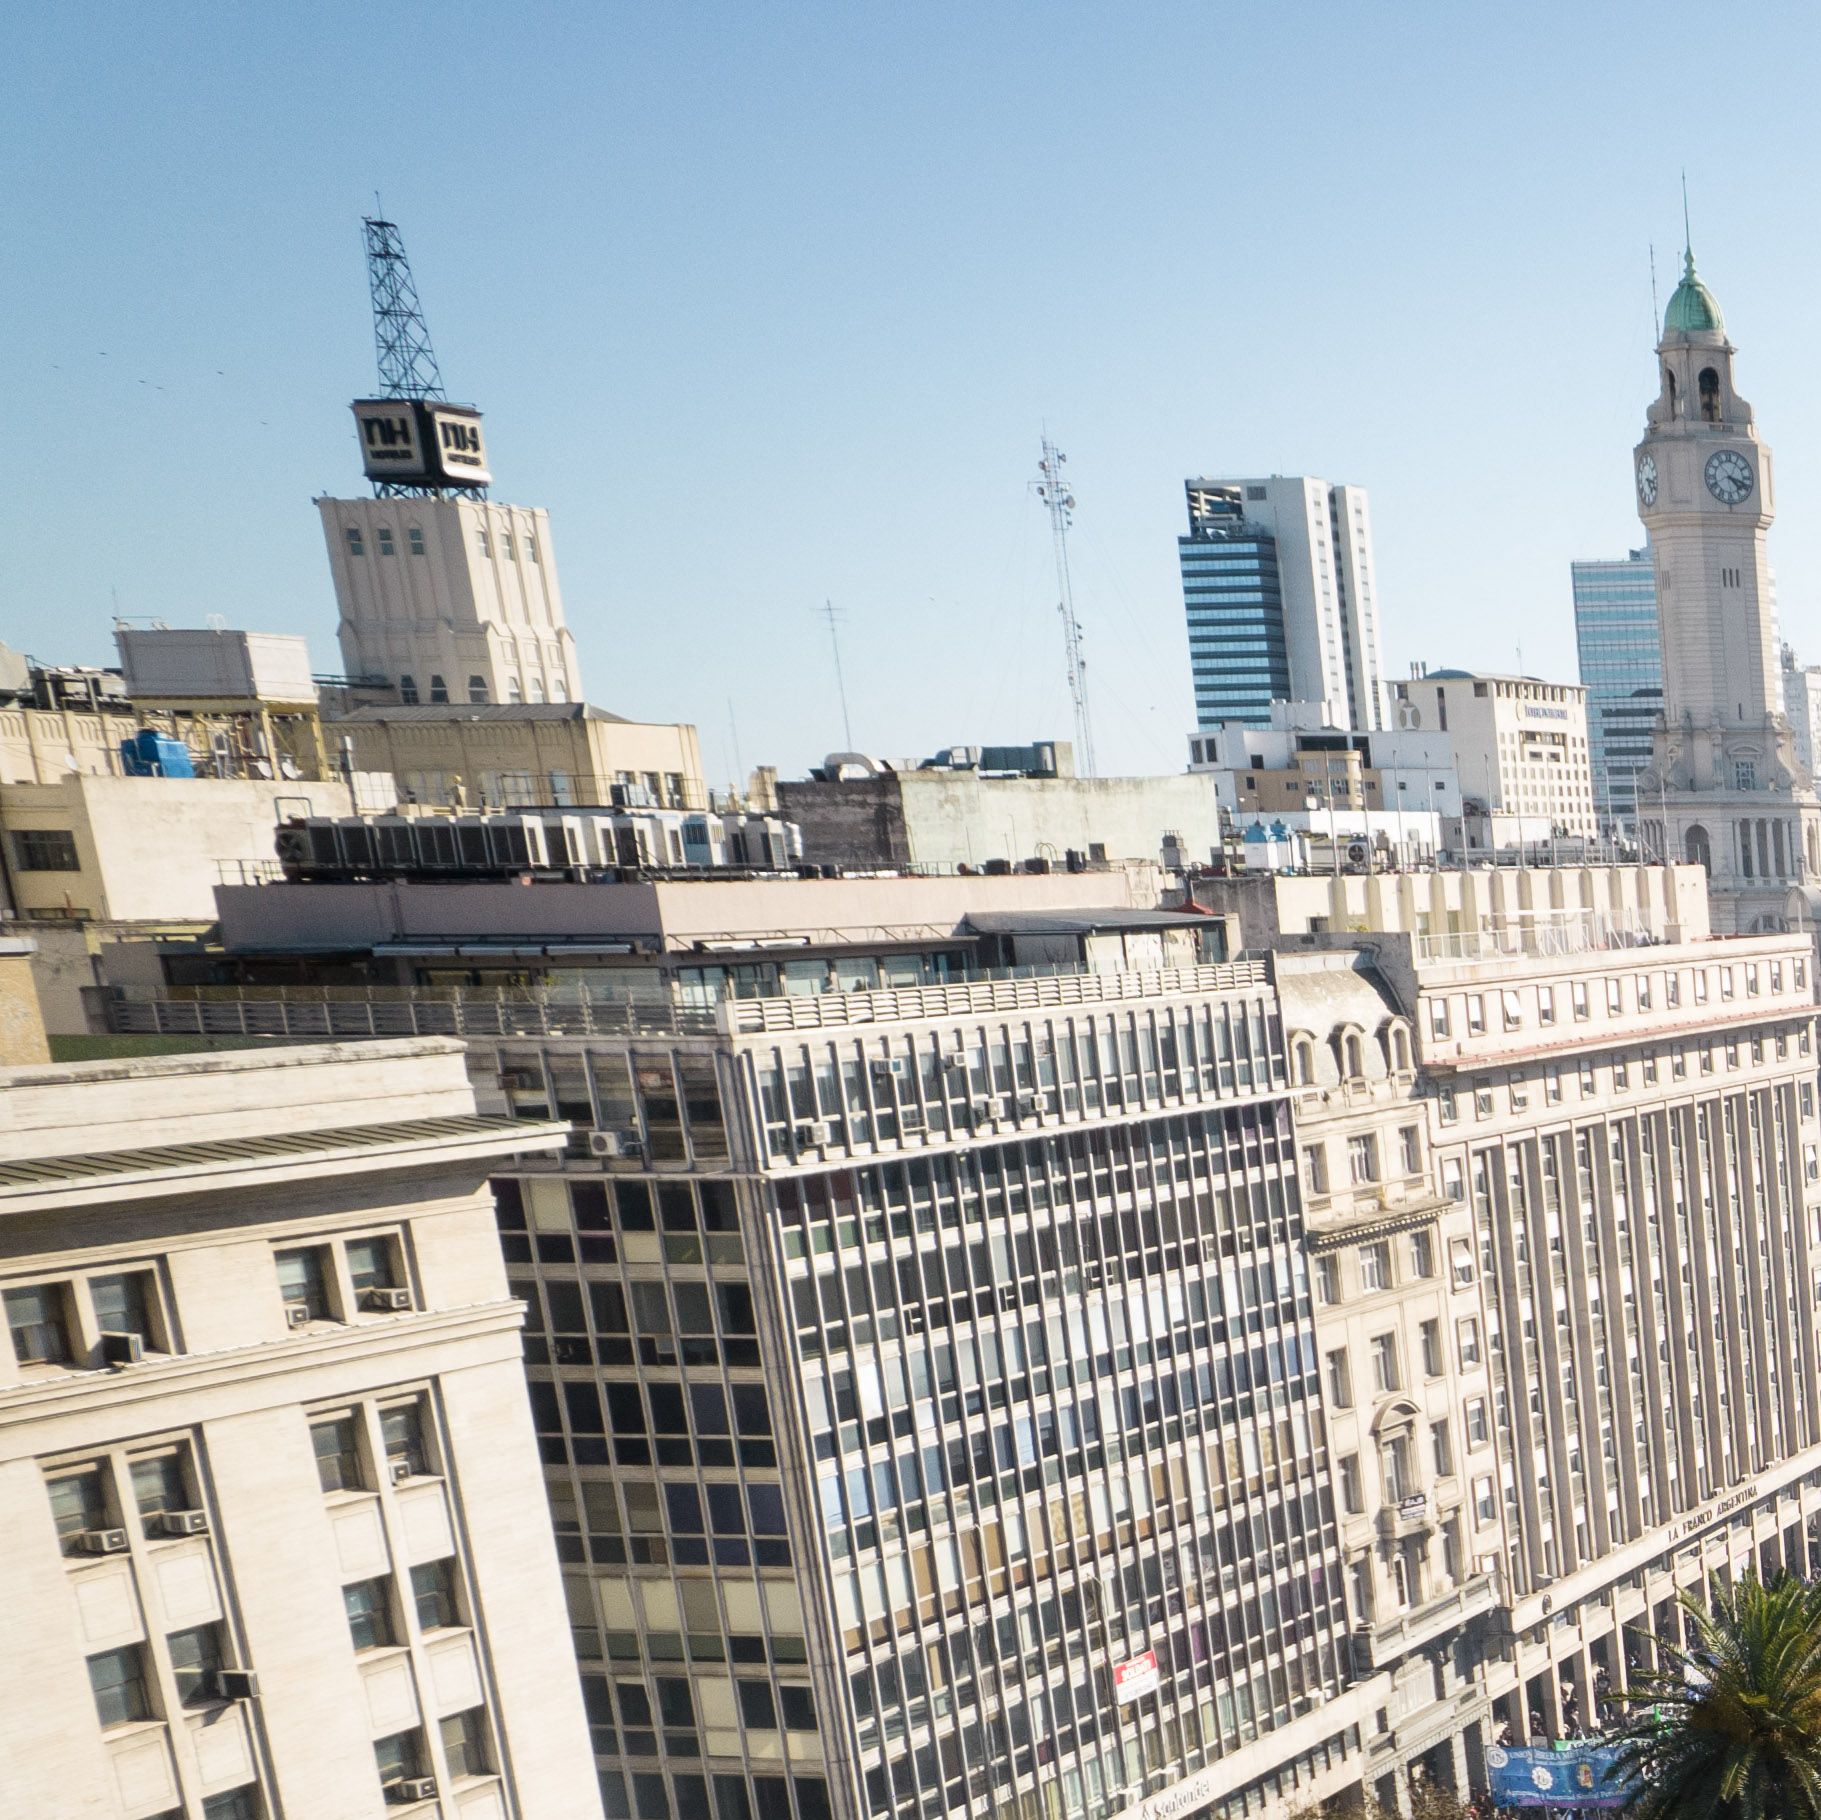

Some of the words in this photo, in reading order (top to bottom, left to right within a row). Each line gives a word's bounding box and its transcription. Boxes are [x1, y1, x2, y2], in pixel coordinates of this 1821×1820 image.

[1668, 1527, 1679, 1542] LA
[1682, 1509, 1712, 1536] FRANCO
[1717, 1485, 1758, 1518] ARGENTINA
